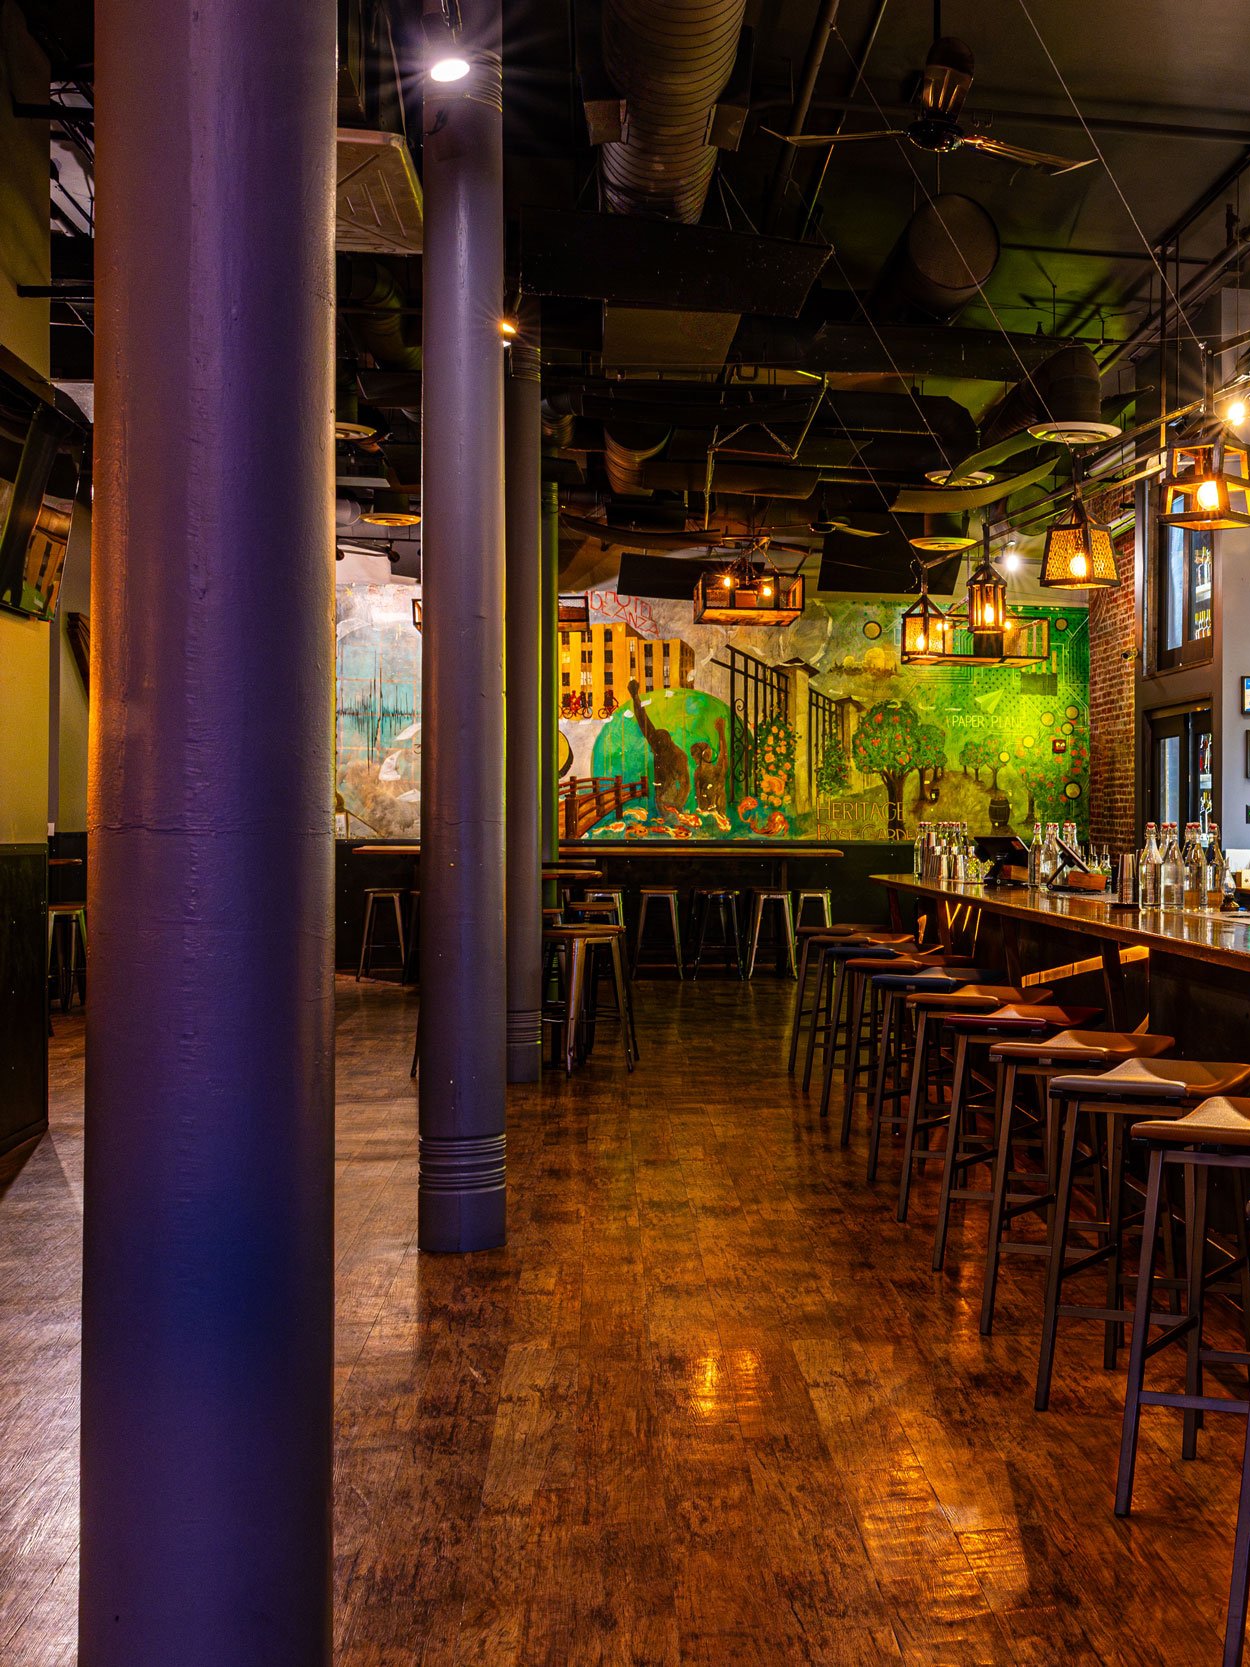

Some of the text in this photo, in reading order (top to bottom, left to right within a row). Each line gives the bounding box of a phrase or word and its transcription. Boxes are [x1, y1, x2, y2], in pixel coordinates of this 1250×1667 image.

[952, 715, 1026, 728] PAPER PLANE
[816, 798, 907, 821] HERITAGE
[816, 824, 857, 841] ROSE
